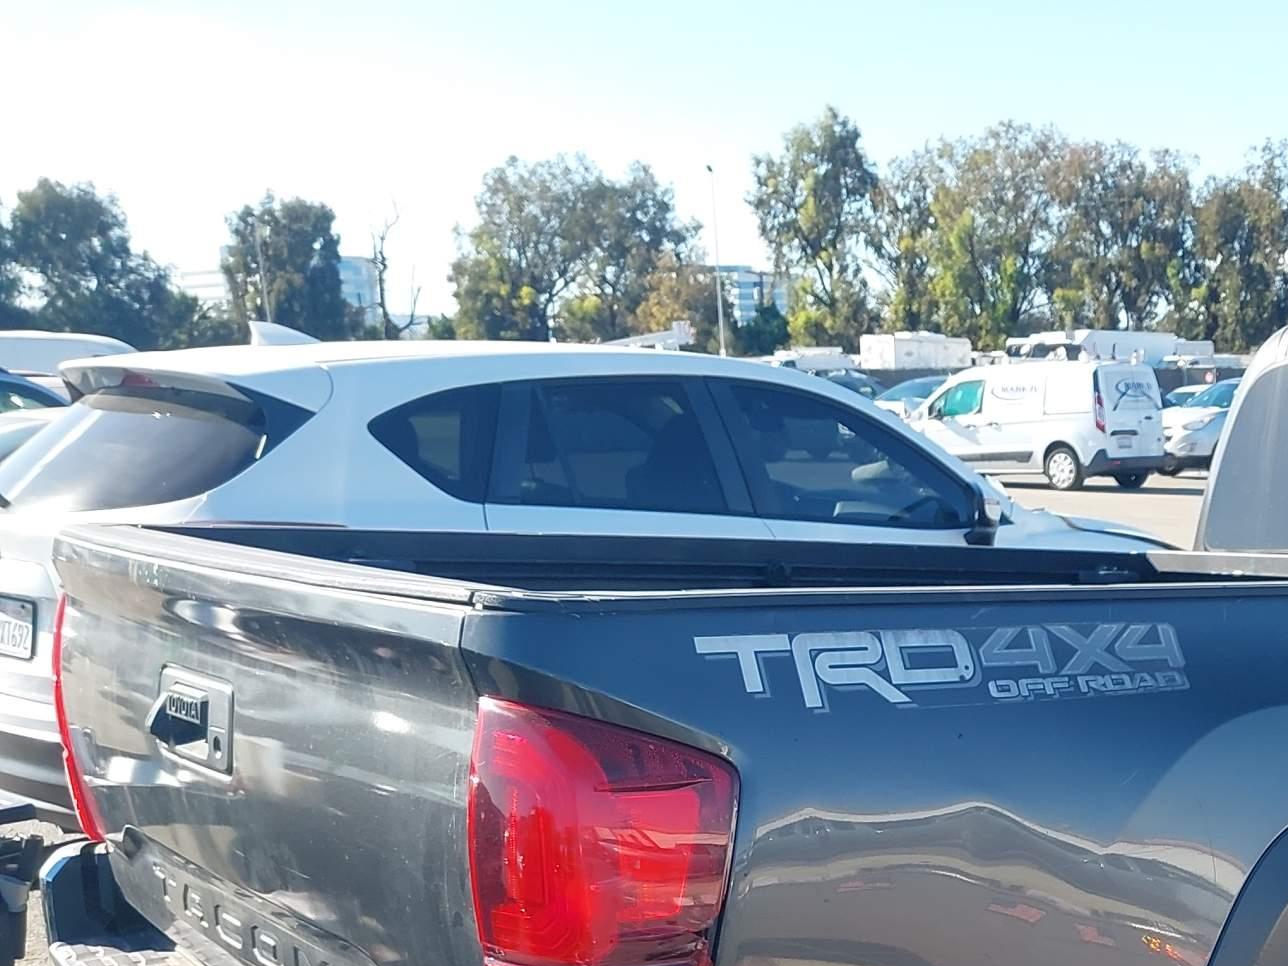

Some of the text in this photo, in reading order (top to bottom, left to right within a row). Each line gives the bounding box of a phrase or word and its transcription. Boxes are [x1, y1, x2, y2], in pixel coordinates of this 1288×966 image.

[694, 623, 1187, 711] TRD 4X4
[988, 671, 1190, 700] OFF ROAD
